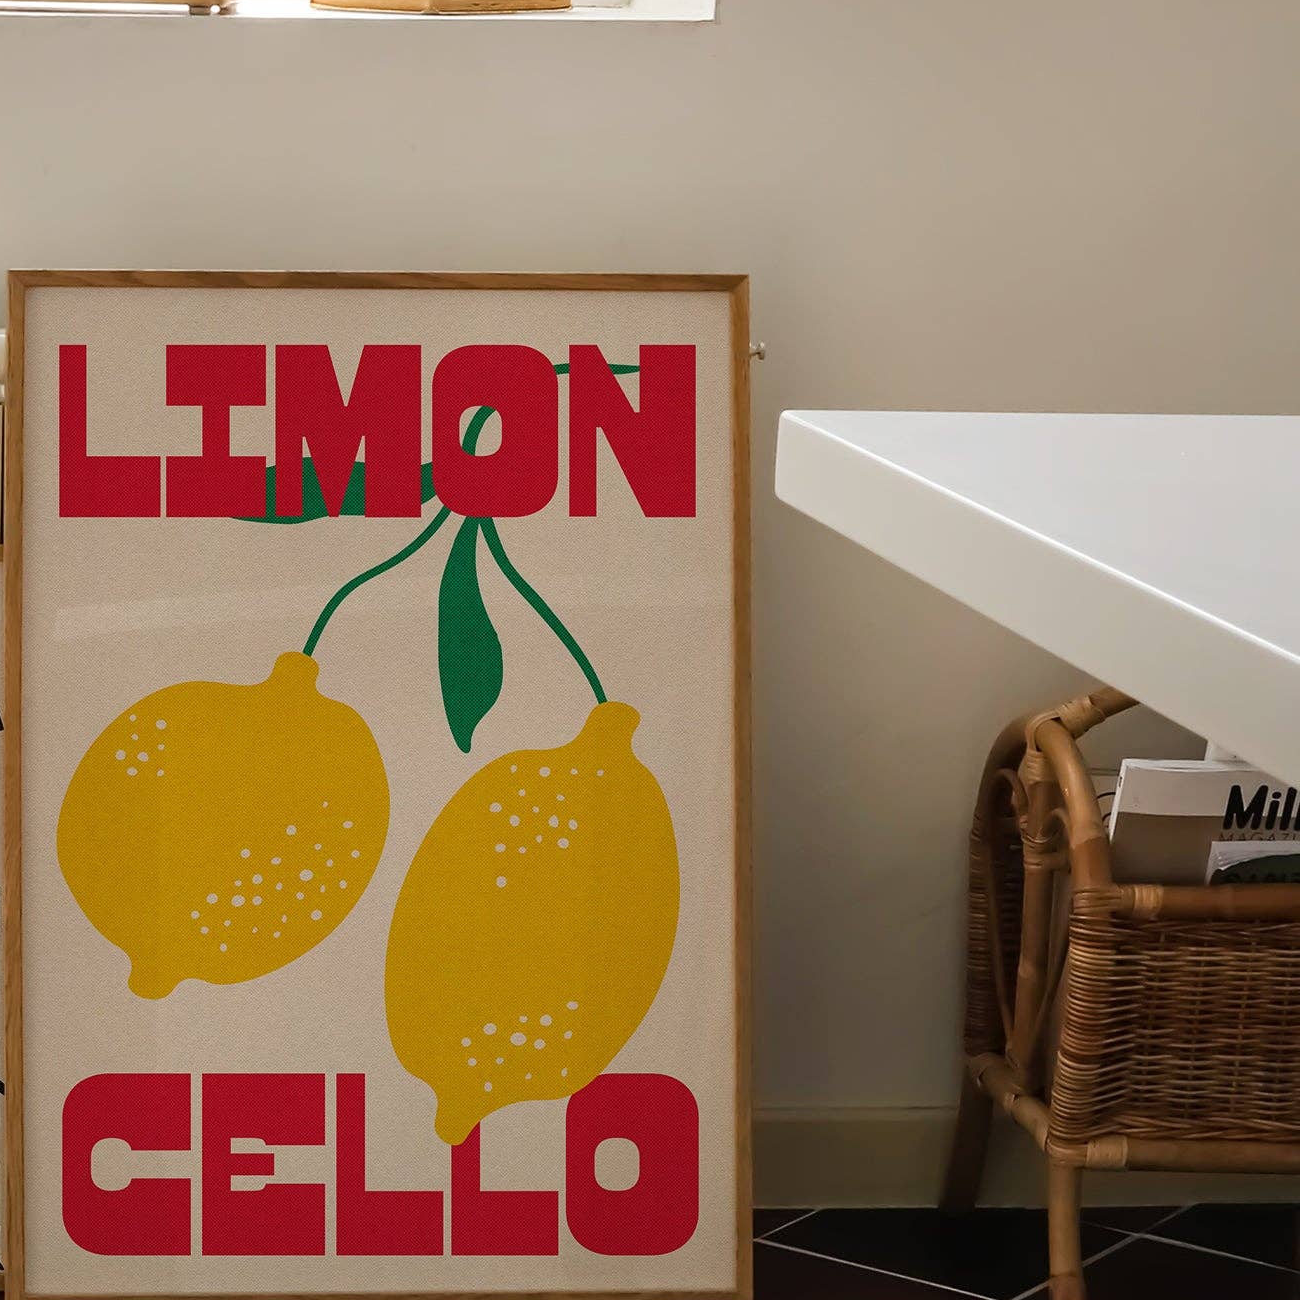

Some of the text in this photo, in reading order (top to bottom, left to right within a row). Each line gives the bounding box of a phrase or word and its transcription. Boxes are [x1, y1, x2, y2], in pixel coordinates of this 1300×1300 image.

[57, 343, 697, 518] LIMON
[1222, 784, 1300, 831] Mil
[61, 1072, 700, 1257] CELLO
